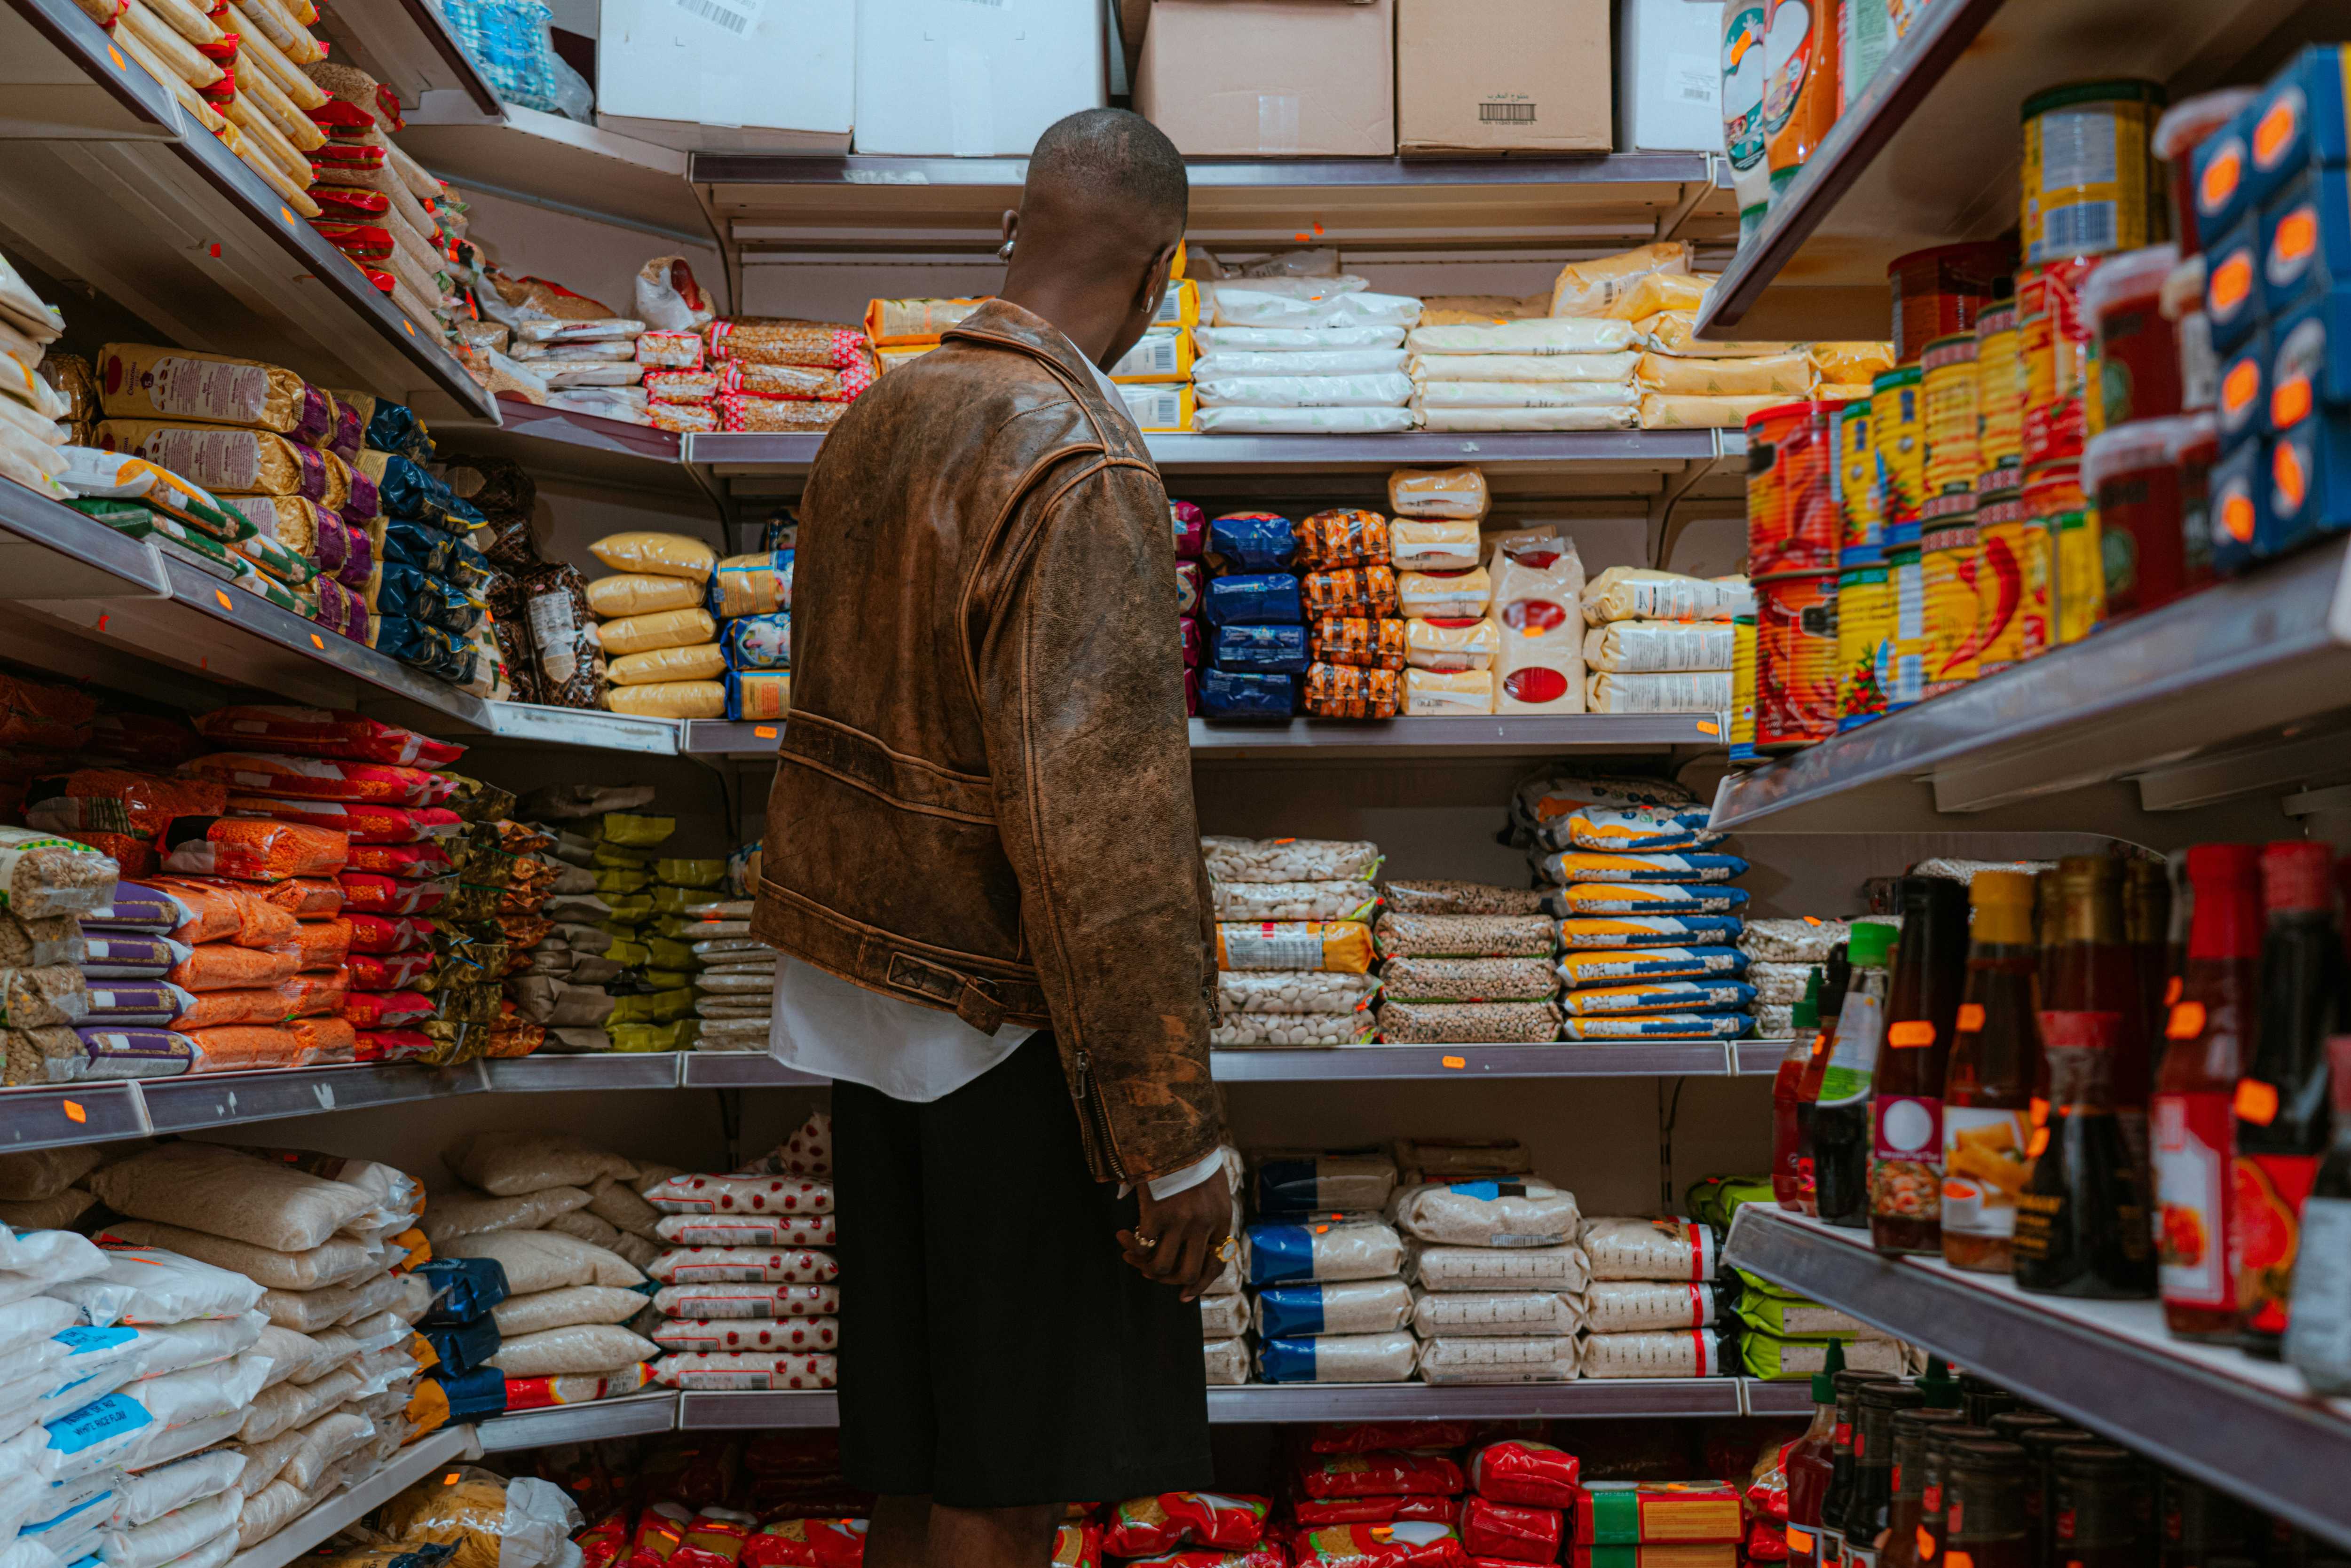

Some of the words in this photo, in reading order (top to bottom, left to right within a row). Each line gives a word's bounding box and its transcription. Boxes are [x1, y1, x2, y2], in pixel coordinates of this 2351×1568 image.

[102, 1399, 117, 1409] RIZ
[74, 1423, 96, 1435] WHITE
[94, 1416, 110, 1428] RICE
